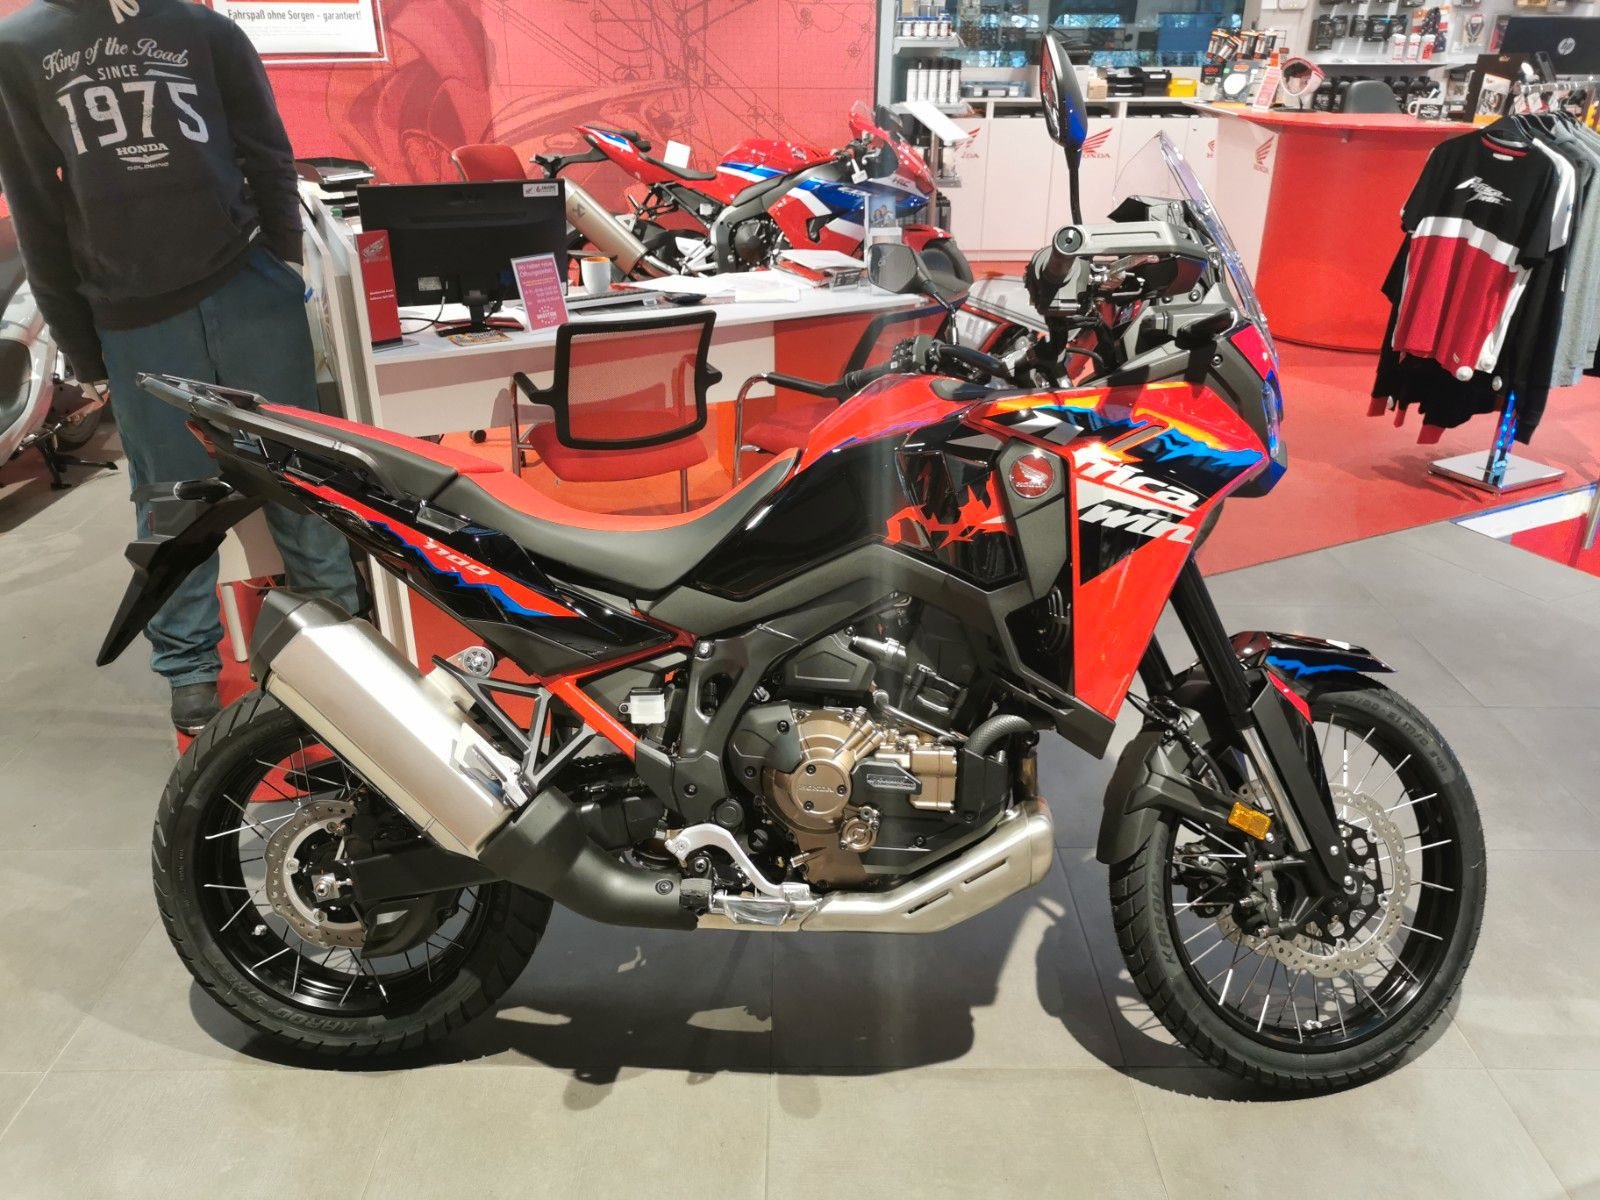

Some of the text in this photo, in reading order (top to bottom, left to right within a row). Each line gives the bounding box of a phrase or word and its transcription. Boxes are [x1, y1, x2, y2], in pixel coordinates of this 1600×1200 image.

[267, 10, 286, 20] ohne
[288, 10, 315, 22] Sorgen
[323, 11, 363, 22] garantiert!
[42, 37, 189, 80] King of the Road
[97, 64, 139, 81] SINCE
[57, 81, 209, 155] 1975
[115, 142, 169, 156] HONDA
